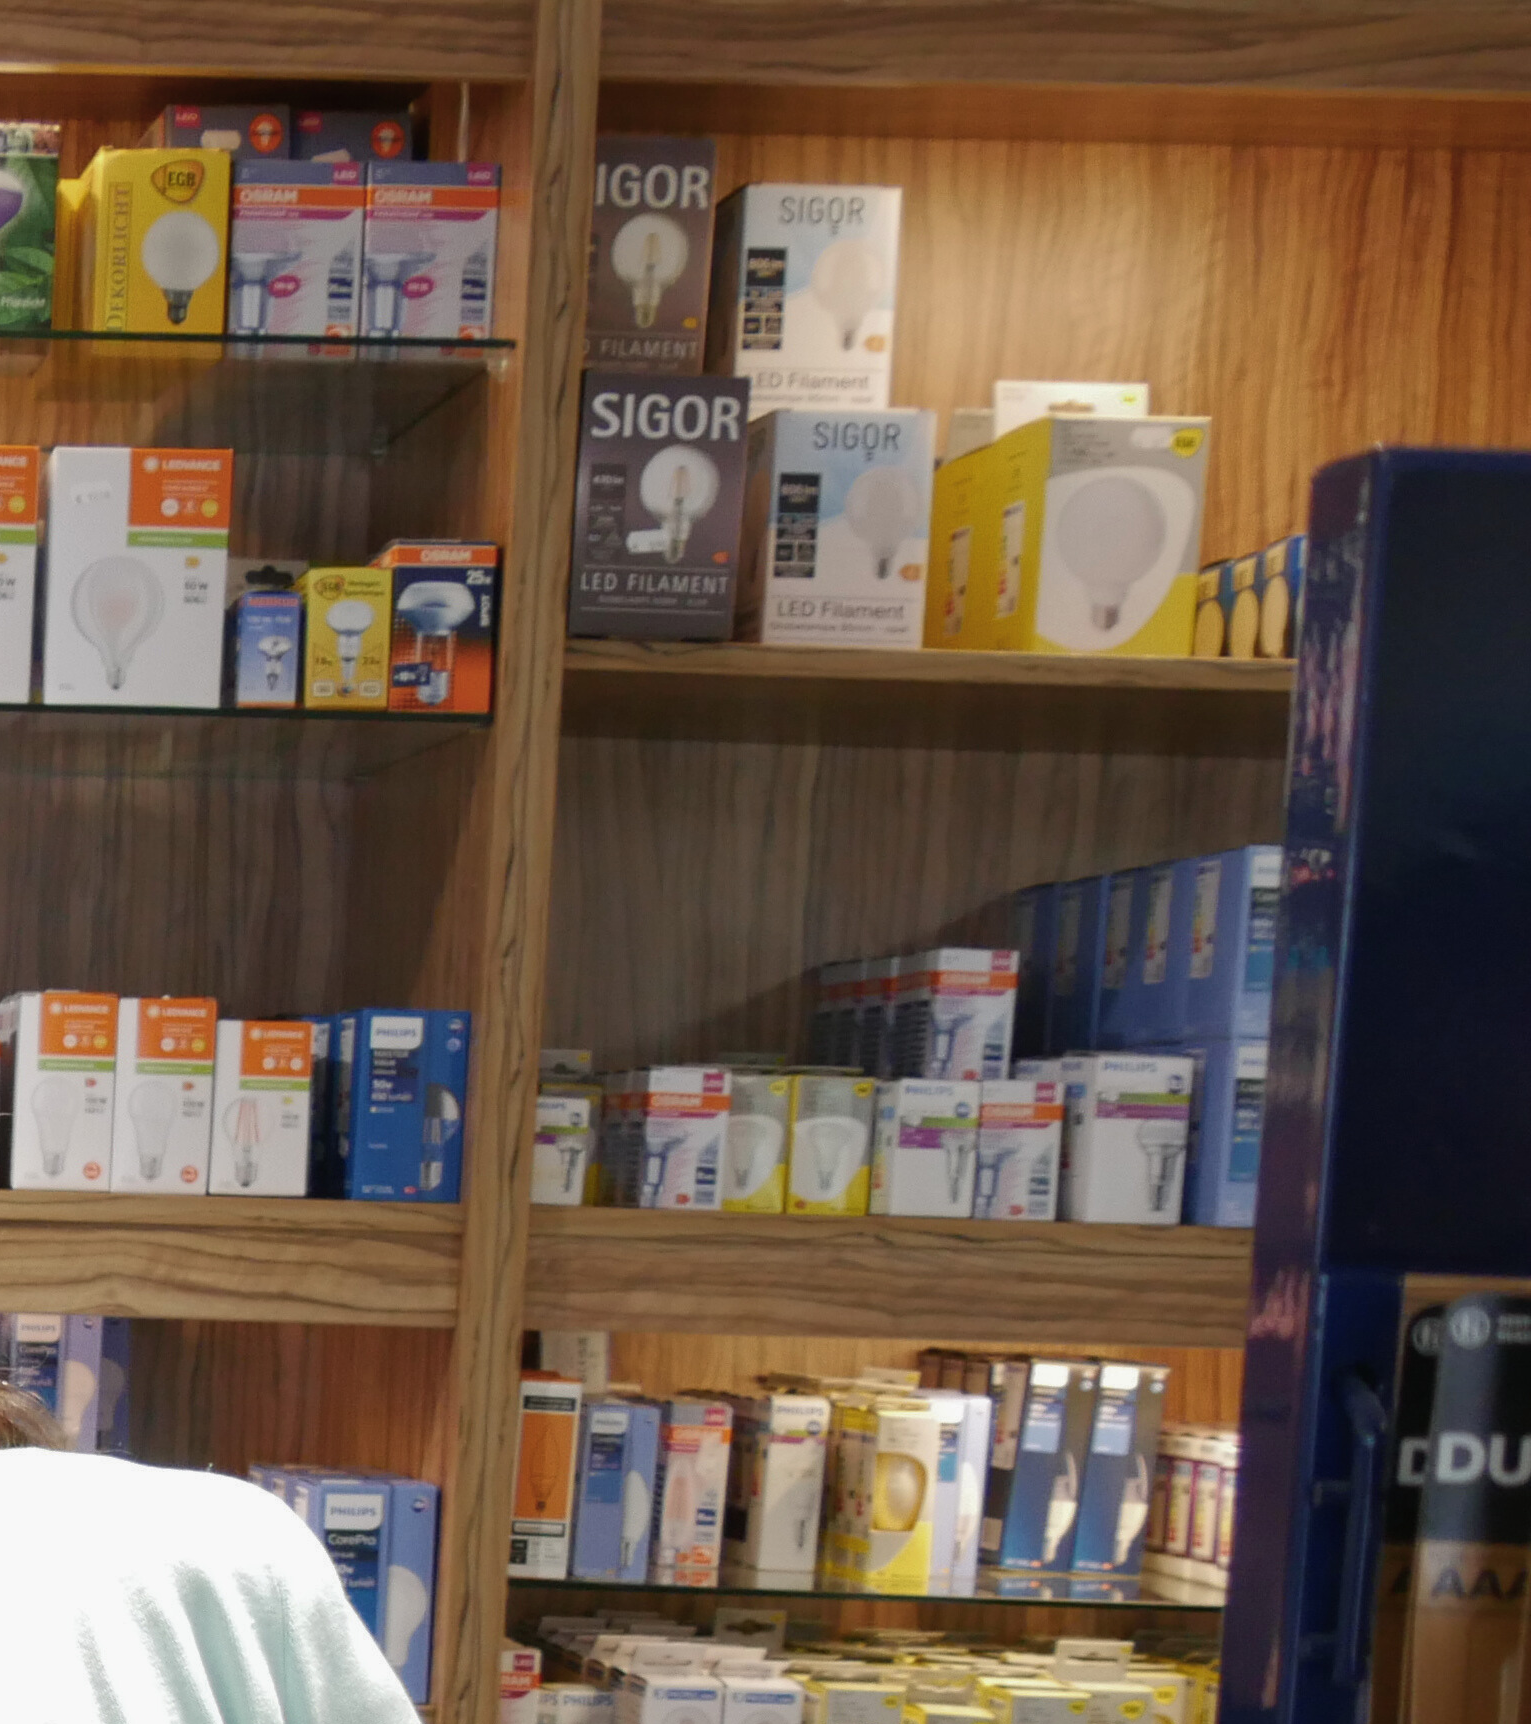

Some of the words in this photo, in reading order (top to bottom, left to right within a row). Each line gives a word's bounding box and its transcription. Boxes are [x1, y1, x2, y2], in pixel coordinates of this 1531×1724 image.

[595, 164, 709, 208] IGOR
[779, 197, 865, 224] SIGOR
[108, 186, 131, 332] DEKORLICHT
[599, 337, 699, 358] FILAMENT
[787, 372, 869, 391] Filament
[590, 393, 739, 441] SIGOR
[813, 422, 901, 452] SIGOR
[161, 459, 222, 472] LEDVANCE
[581, 573, 619, 592] LED
[627, 575, 728, 594] FILAMENT
[777, 601, 806, 619] LED
[812, 602, 903, 622] Filament
[330, 1506, 377, 1518] PHILIPS
[329, 1533, 377, 1546] CorePro
